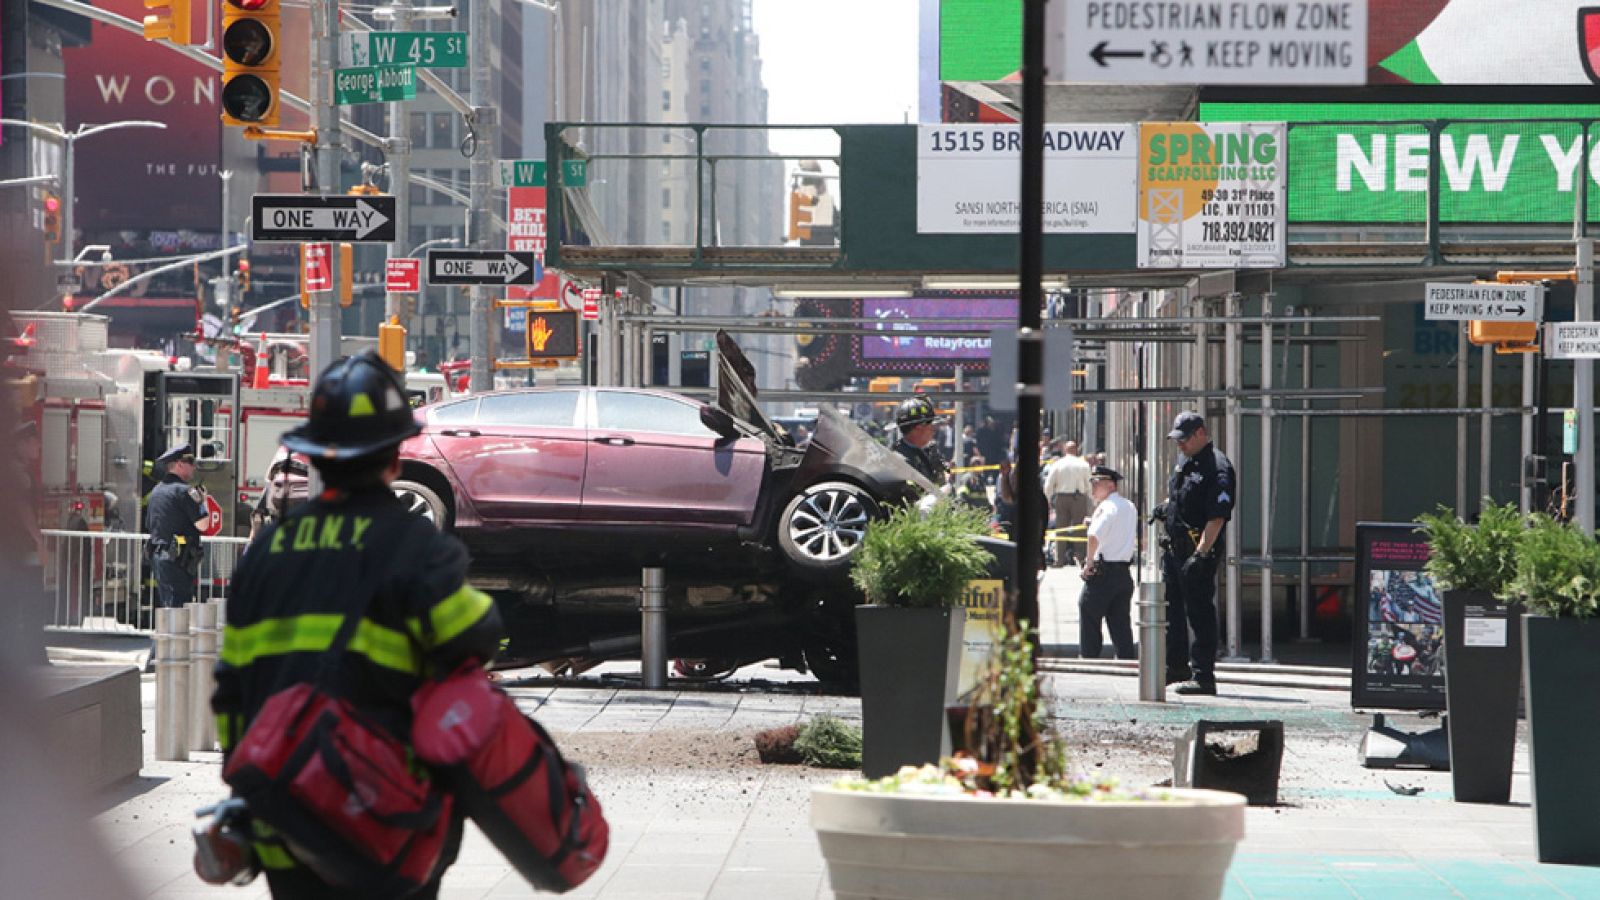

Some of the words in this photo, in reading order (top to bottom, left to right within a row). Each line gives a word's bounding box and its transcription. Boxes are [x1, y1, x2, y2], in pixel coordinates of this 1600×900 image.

[1088, 3, 1222, 29] PEDESTRIAN
[1230, 3, 1287, 29] FLOW
[1296, 3, 1352, 29] ZONE
[375, 37, 396, 63] W
[408, 37, 435, 63] 45
[446, 37, 462, 54] St
[1206, 41, 1260, 67] KEEP
[1268, 41, 1353, 67] MOVING
[337, 72, 375, 94] George
[378, 67, 413, 88] Abbott
[931, 131, 984, 151] 1515
[992, 131, 1125, 151] BRADWAY
[1149, 133, 1277, 165] SPRING
[146, 163, 176, 176] THE
[1336, 134, 1520, 192] NEW
[1539, 134, 1600, 192] Y
[518, 164, 534, 183] W
[1148, 166, 1248, 181] SCAFFOLDING
[1251, 166, 1275, 180] LLC
[1202, 189, 1229, 201] 49-30
[1249, 189, 1274, 201] Place
[513, 208, 545, 222] BET
[955, 202, 983, 215] SANSI
[986, 202, 1020, 215] NORTH
[1070, 202, 1098, 216] (SNA)
[1227, 204, 1241, 216] NY
[1245, 204, 1275, 216] 11101
[273, 210, 313, 228] ONE
[333, 210, 375, 228] WAY
[1203, 221, 1275, 242] 718.392.4921
[443, 261, 473, 275] ONE
[487, 261, 518, 275] WAY
[1431, 288, 1480, 300] PEDESTRIAN
[1482, 289, 1504, 300] FLOW
[1505, 290, 1527, 301] ZONE
[1430, 304, 1449, 315] KEEP
[1452, 304, 1483, 316] MOVING
[1558, 327, 1599, 339] PEDESTRIAN
[1558, 341, 1575, 353] KEEP
